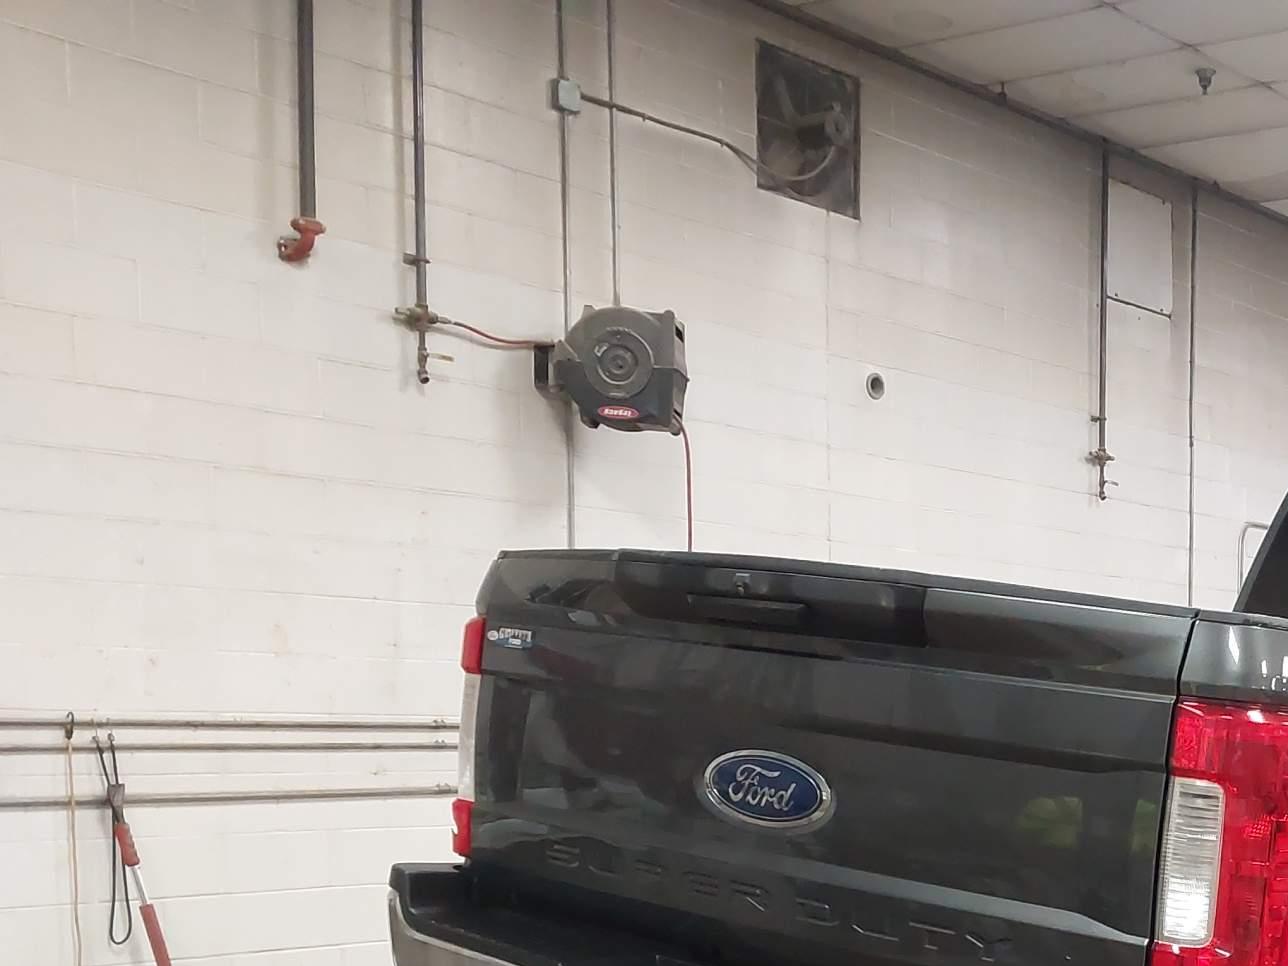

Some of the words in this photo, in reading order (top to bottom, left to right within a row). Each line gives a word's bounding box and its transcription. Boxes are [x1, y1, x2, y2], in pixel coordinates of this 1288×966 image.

[728, 763, 797, 811] Ford
[545, 843, 770, 912] SUPER
[795, 897, 1013, 963] DUTY
